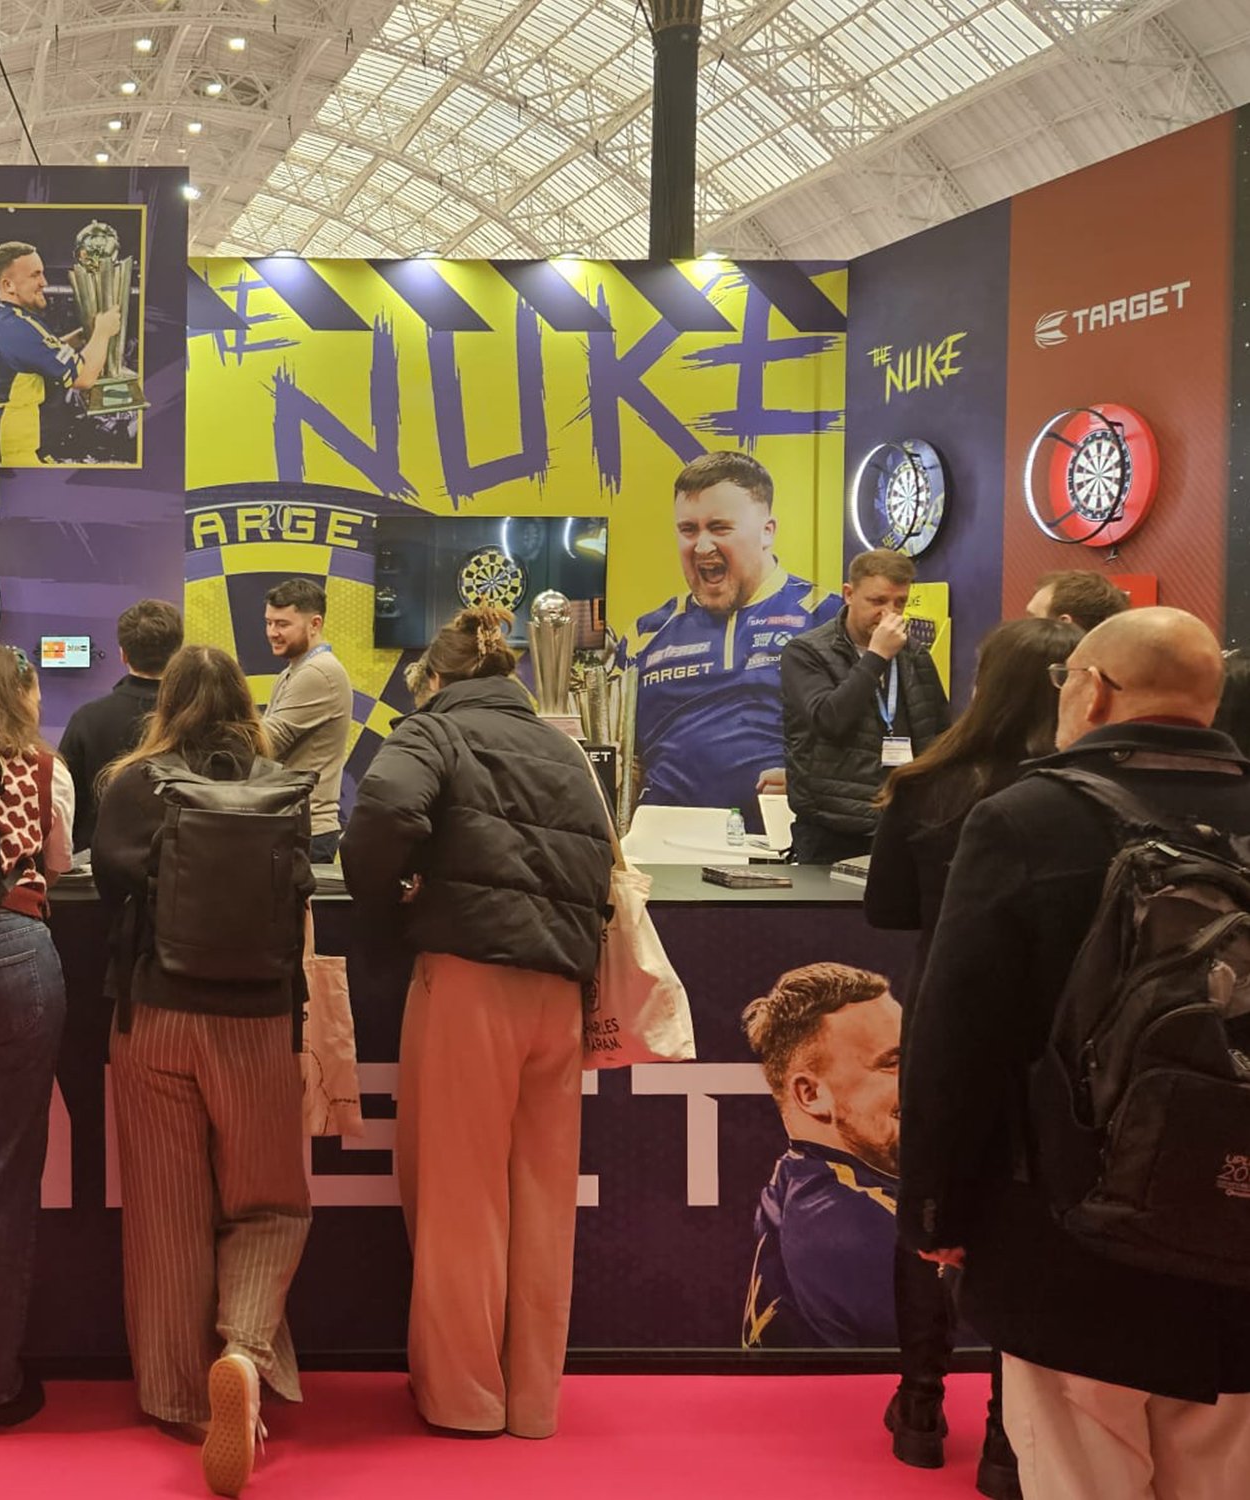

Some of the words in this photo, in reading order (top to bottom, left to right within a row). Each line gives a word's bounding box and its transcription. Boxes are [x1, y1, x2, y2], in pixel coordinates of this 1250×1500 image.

[1072, 280, 1191, 334] TARGET
[866, 345, 894, 367] THE
[884, 331, 968, 404] NUKE
[258, 258, 848, 512] NUKE
[192, 507, 377, 549] ARGE
[260, 503, 294, 532] 20
[642, 662, 715, 688] TARGET
